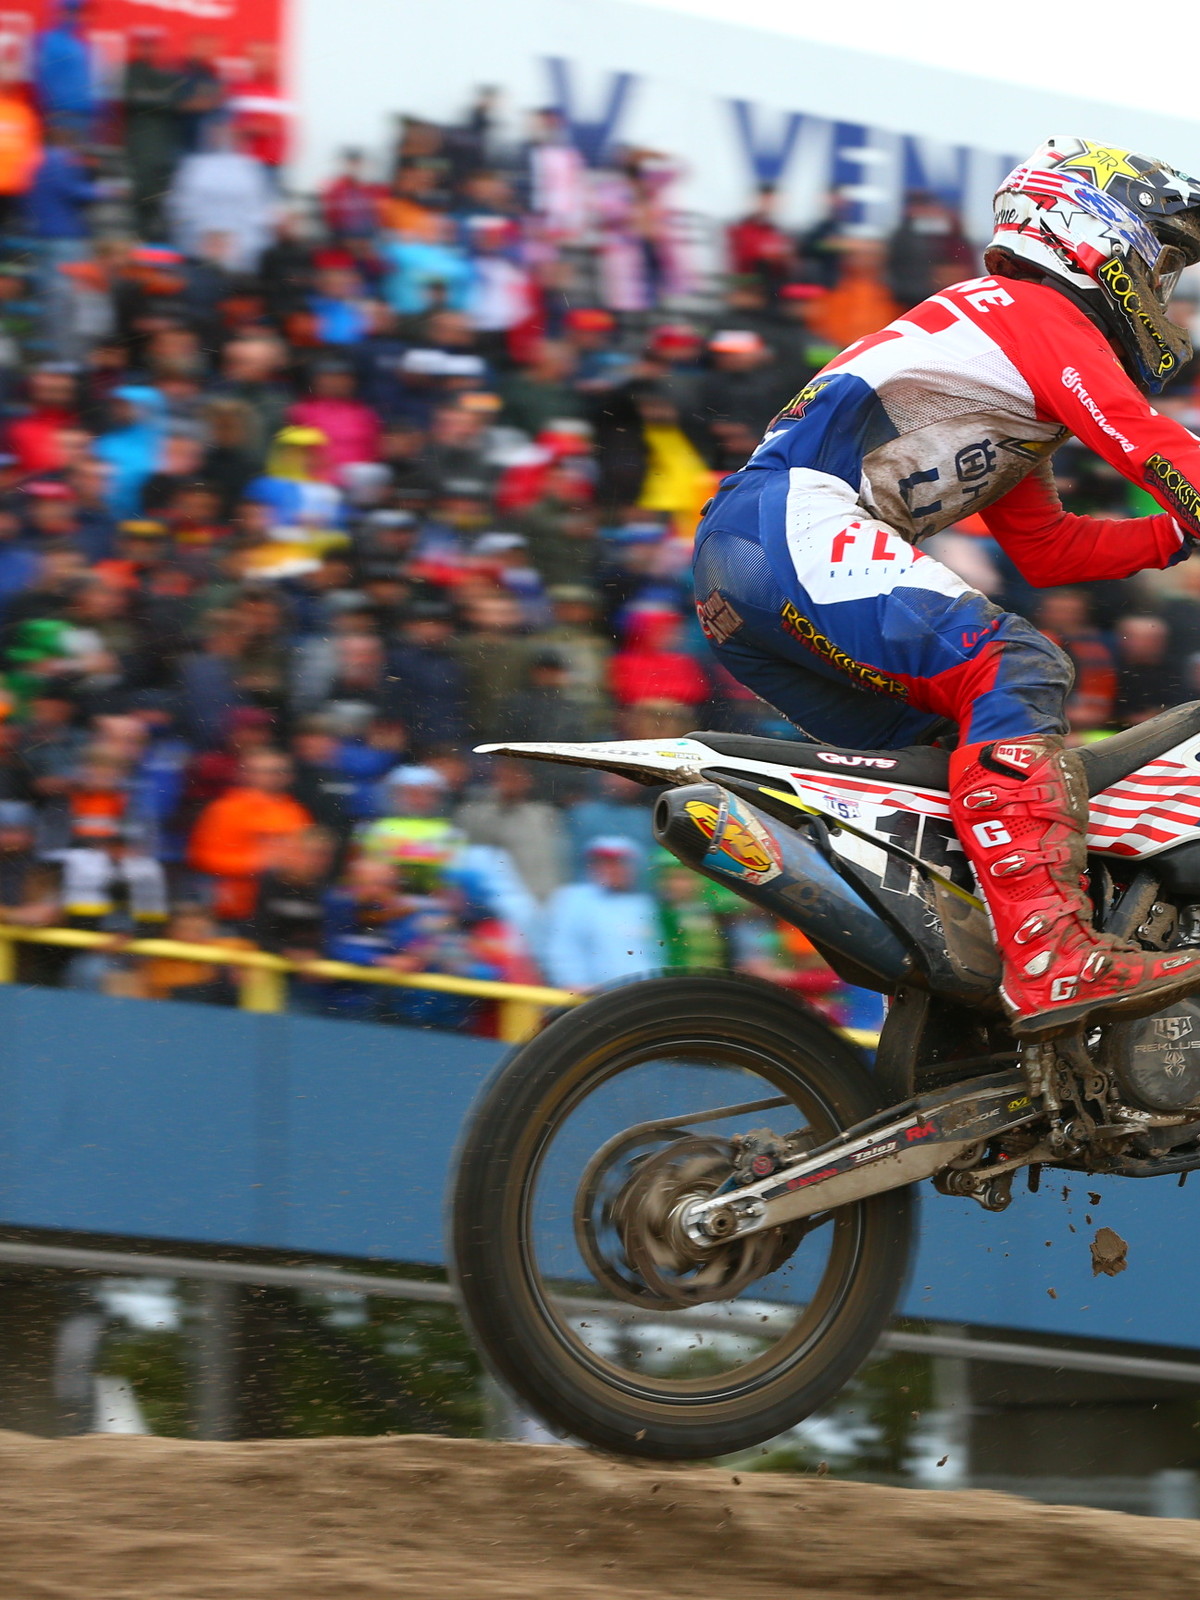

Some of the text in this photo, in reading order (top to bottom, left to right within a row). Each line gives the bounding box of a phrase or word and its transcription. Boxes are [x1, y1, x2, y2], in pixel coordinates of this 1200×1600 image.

[816, 752, 898, 769] GUTS
[1151, 1015, 1194, 1041] USA
[904, 1120, 938, 1142] RK
